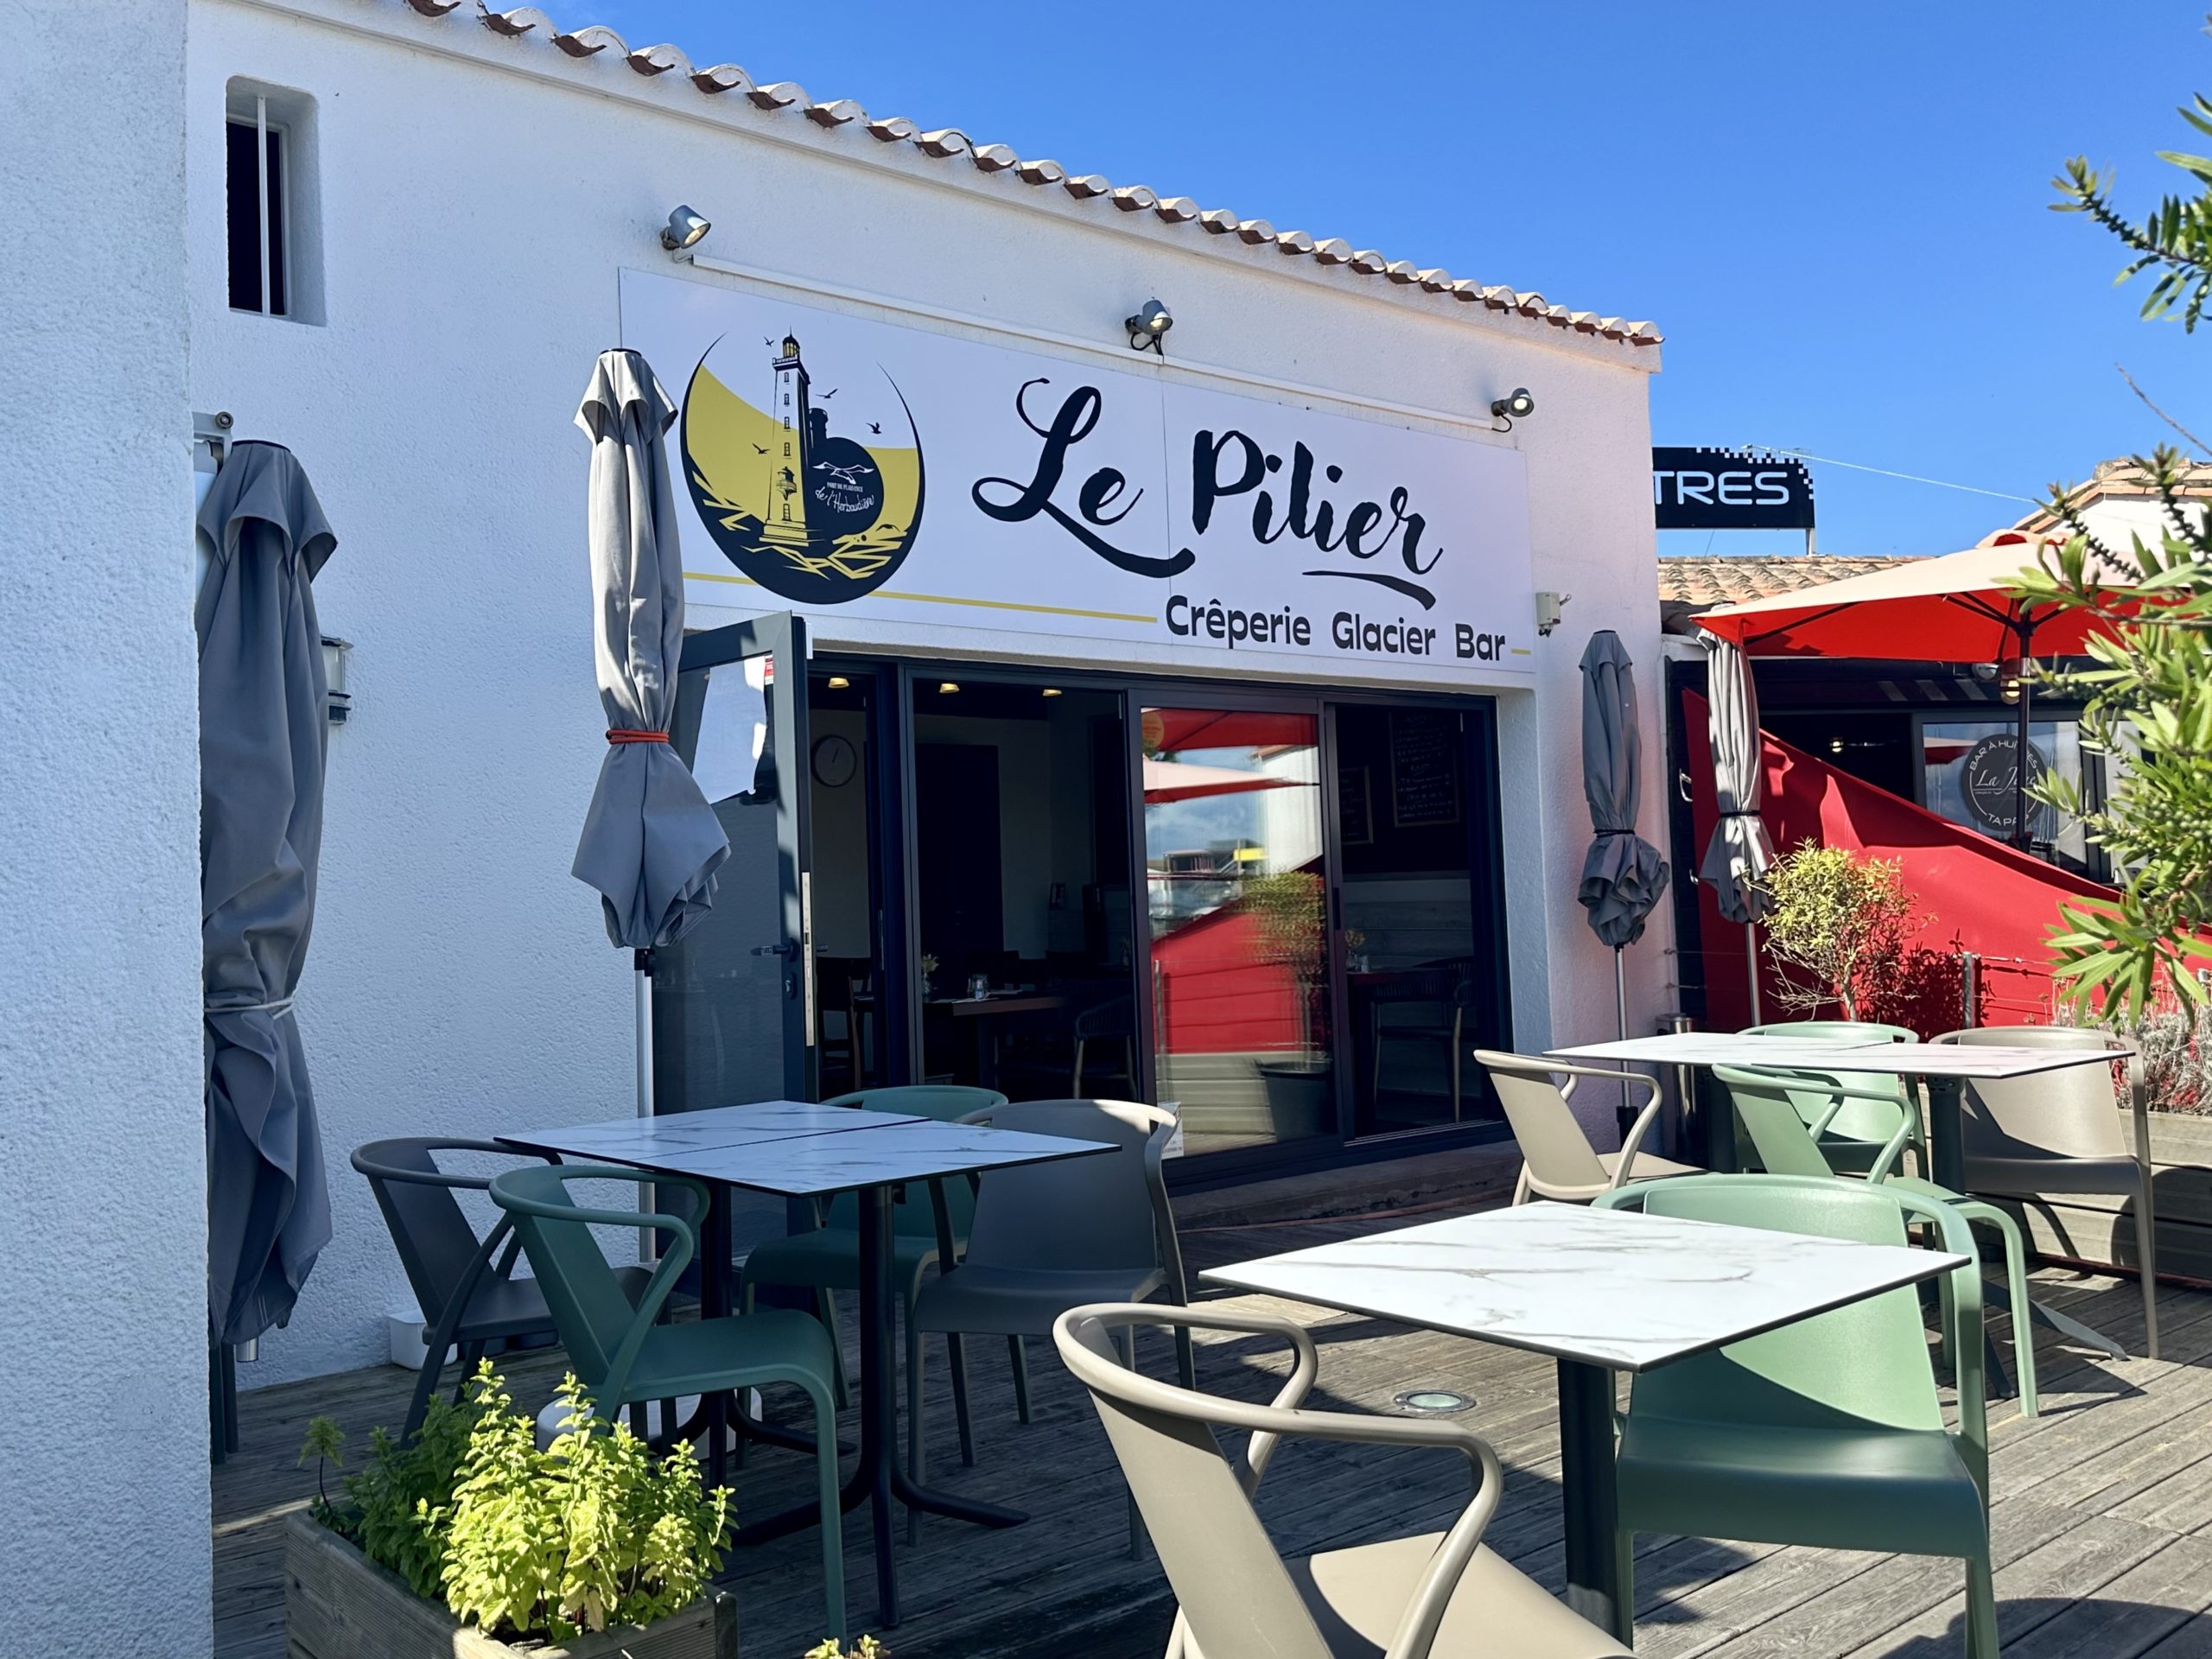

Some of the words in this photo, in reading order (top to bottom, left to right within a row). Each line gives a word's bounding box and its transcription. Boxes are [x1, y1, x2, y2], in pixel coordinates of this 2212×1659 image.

[815, 486, 828, 500] de
[972, 378, 1196, 579] Le
[1192, 429, 1444, 575] Pilier
[1653, 470, 1790, 506] TRES
[1166, 594, 1311, 650] Crêperie
[1332, 611, 1436, 656] Glacier
[1455, 623, 1506, 662] Bar
[1969, 747, 1988, 772] BAR
[1998, 740, 2038, 770] HUÎES
[1975, 769, 1999, 787] La
